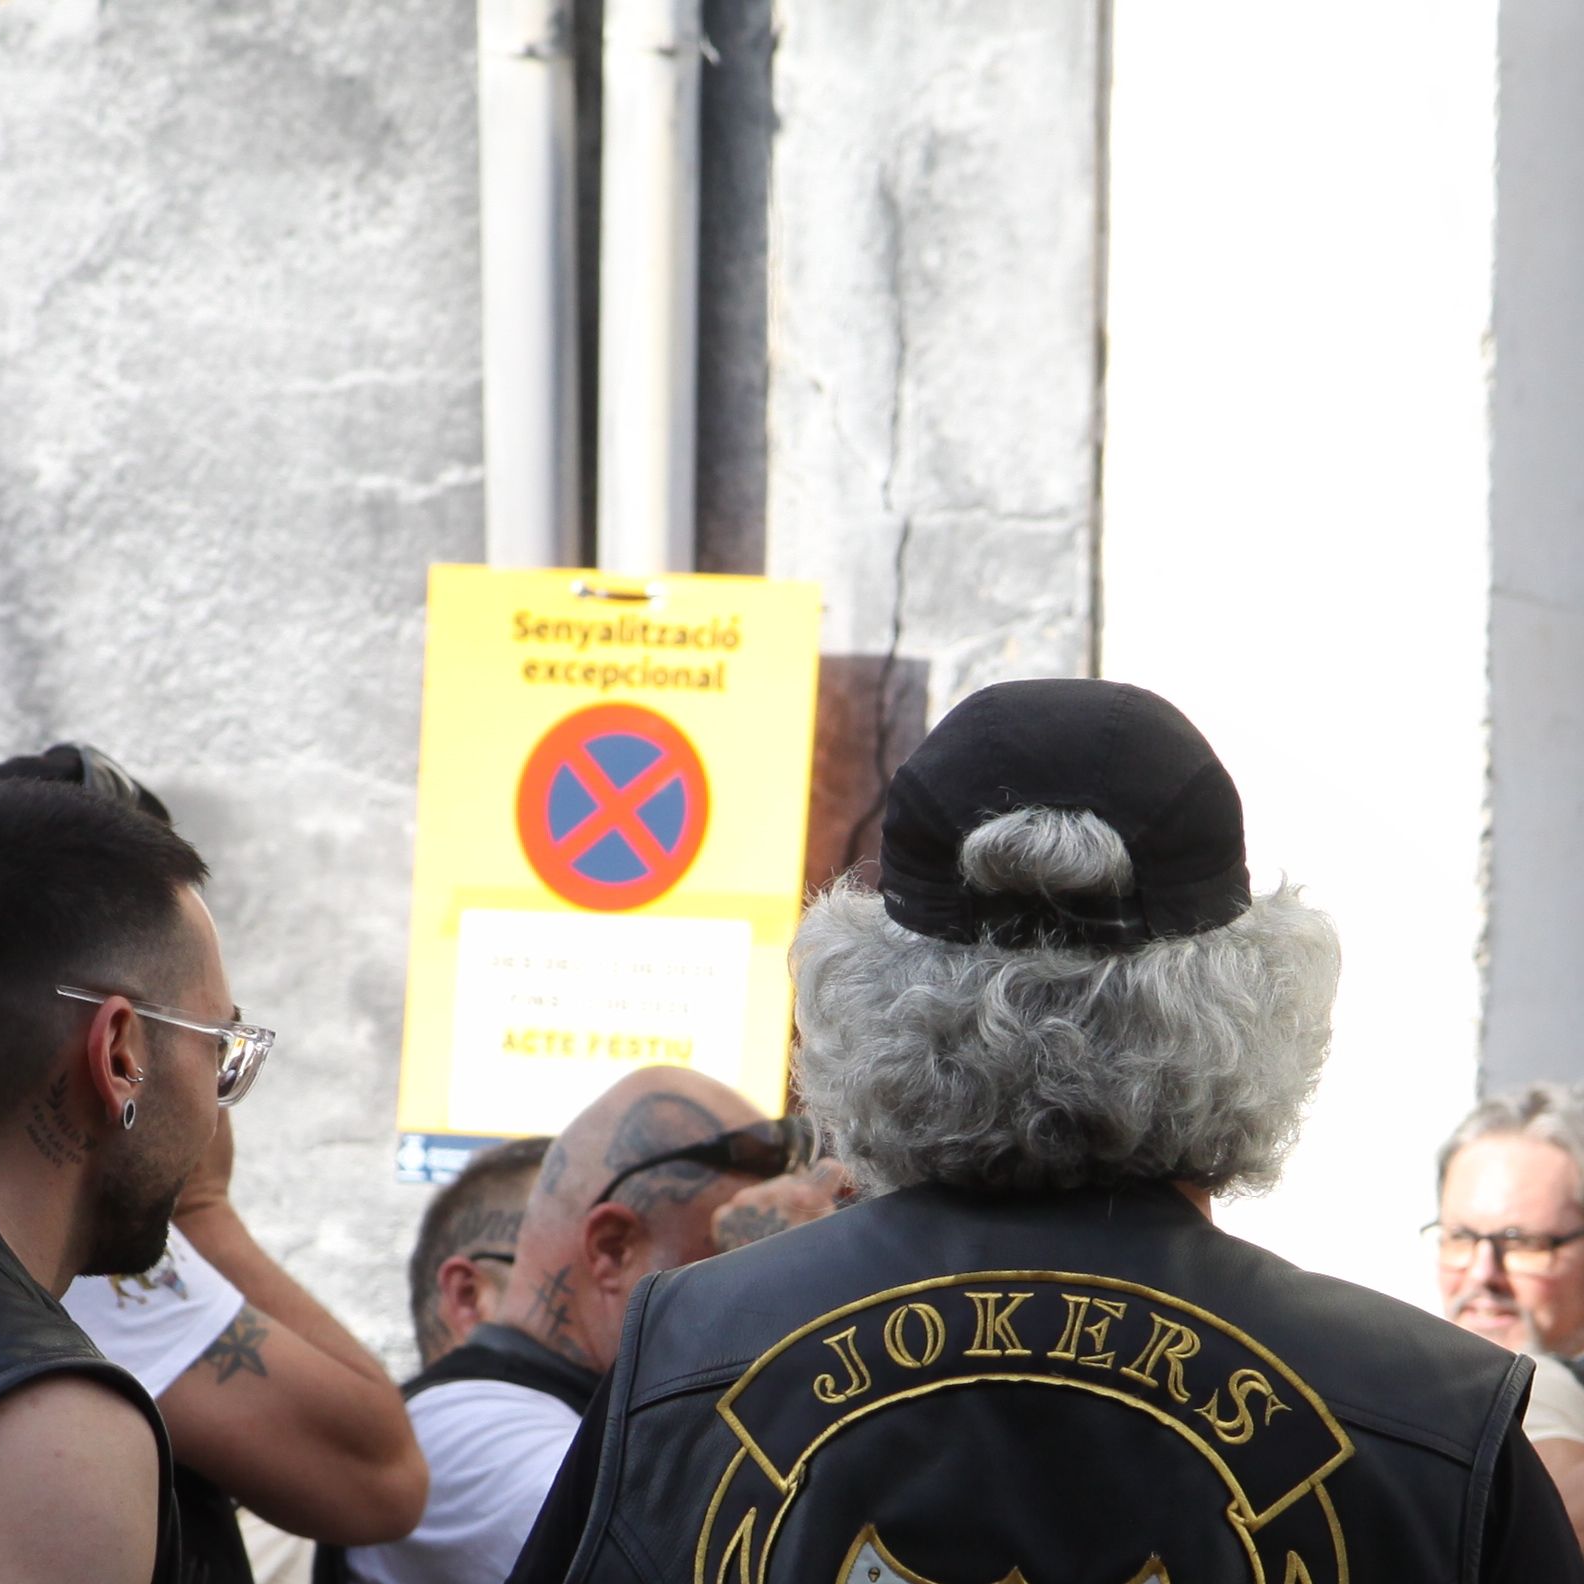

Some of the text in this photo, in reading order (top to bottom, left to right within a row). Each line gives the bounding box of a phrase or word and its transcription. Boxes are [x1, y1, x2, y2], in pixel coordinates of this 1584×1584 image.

[514, 612, 740, 651] Senyalització
[522, 656, 725, 692] excepcional
[813, 1291, 1292, 1446] JOKERS
